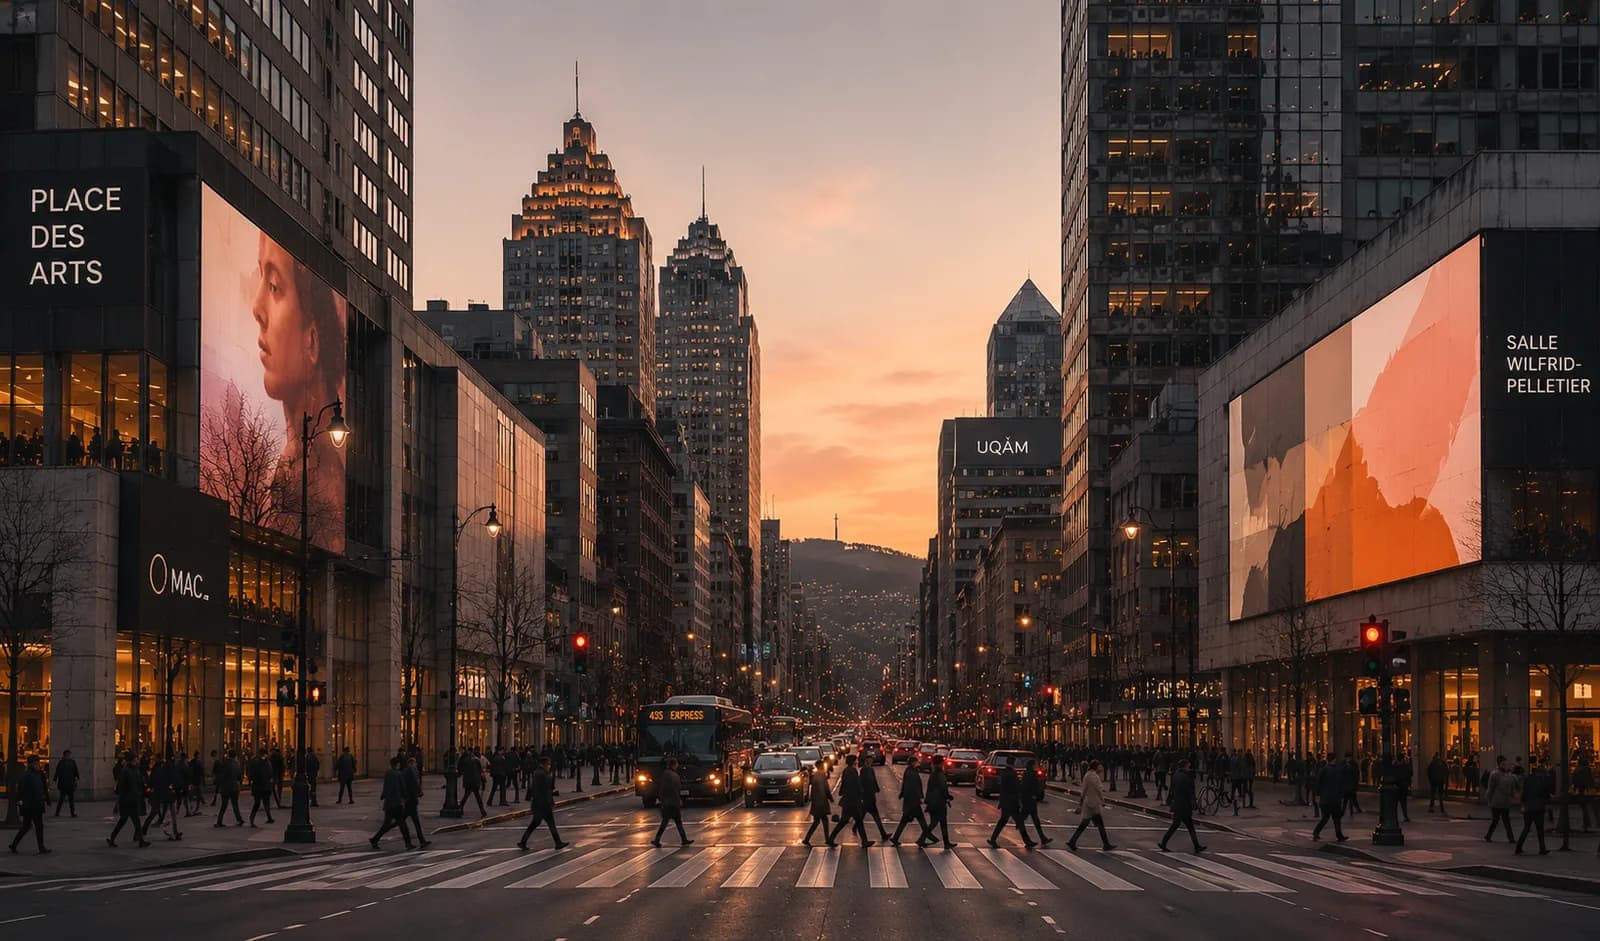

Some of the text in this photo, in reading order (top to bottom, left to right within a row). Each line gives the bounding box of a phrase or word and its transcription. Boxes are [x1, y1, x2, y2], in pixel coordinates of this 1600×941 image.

[31, 187, 122, 213] PLACE
[31, 223, 85, 249] DES
[29, 259, 103, 286] ARTS
[1506, 334, 1558, 350] SALLE
[1506, 356, 1582, 372] WILFRID-
[1507, 378, 1591, 394] PELLETIER
[670, 710, 704, 721] EXPRESS
